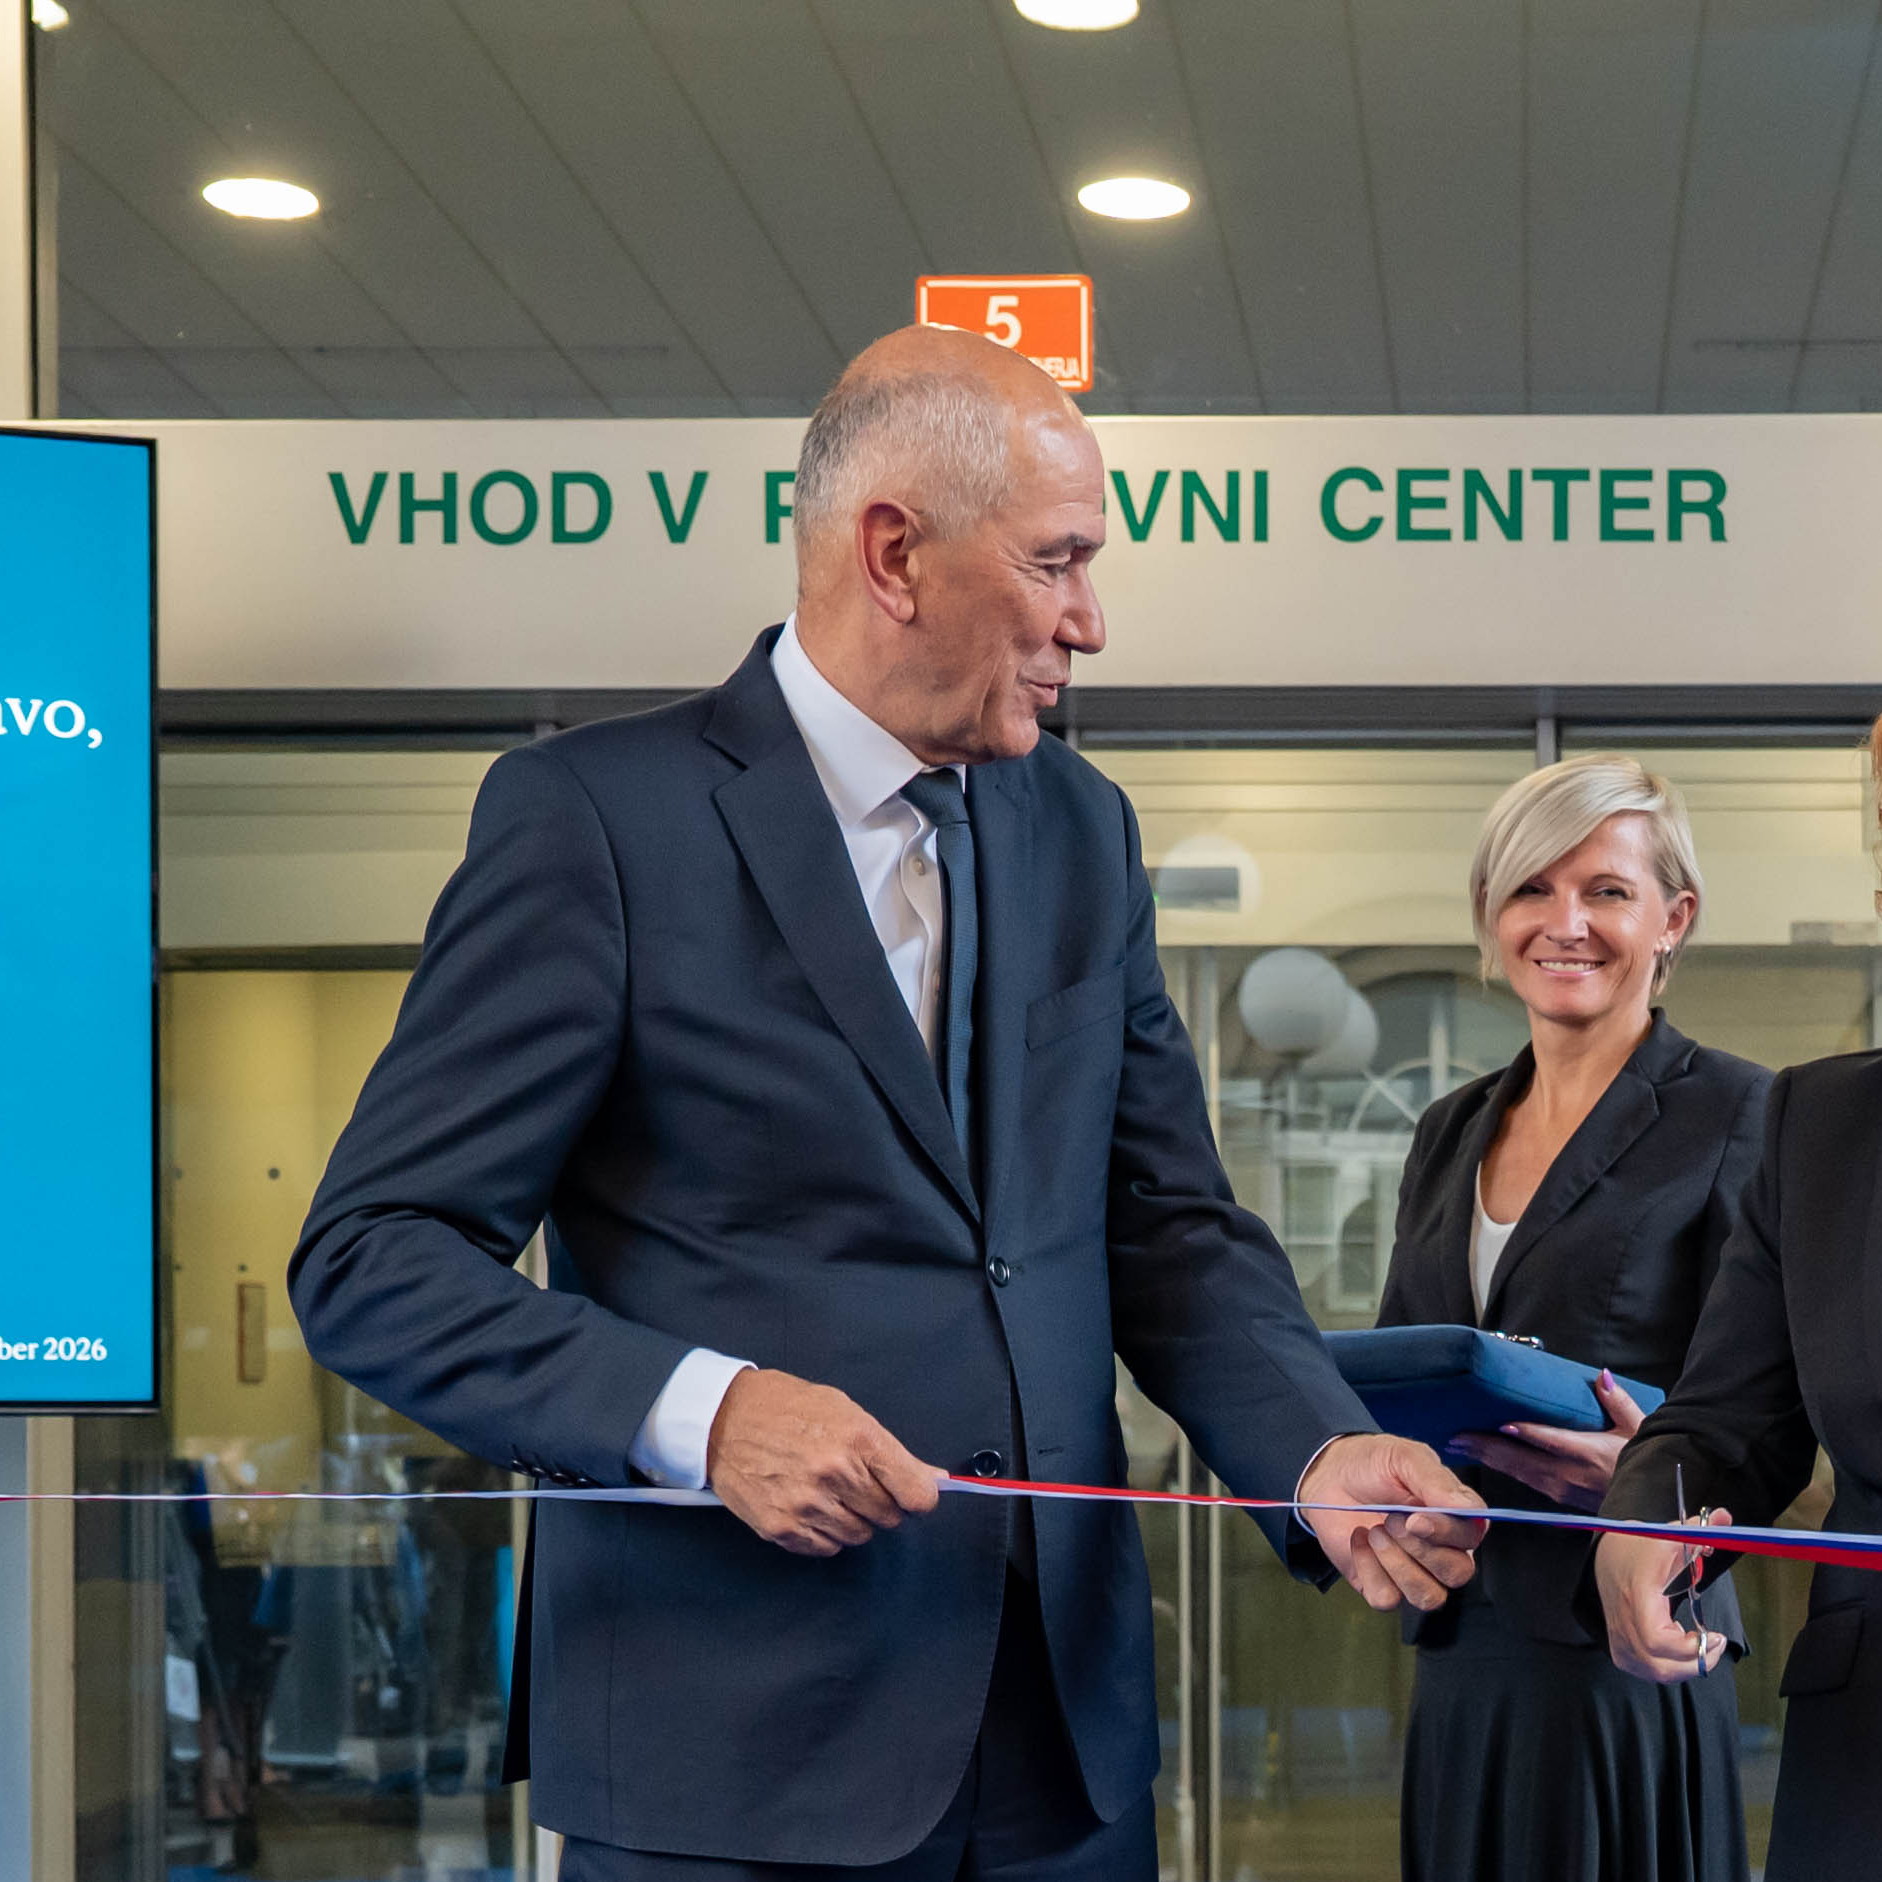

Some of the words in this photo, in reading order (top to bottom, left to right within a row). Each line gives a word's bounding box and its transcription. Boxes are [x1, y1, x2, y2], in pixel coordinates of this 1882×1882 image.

[983, 295, 1022, 349] 5
[329, 471, 613, 546] VHOD
[648, 471, 709, 544] V
[1320, 467, 1727, 543] CENTER
[43, 1336, 108, 1361] 2026
